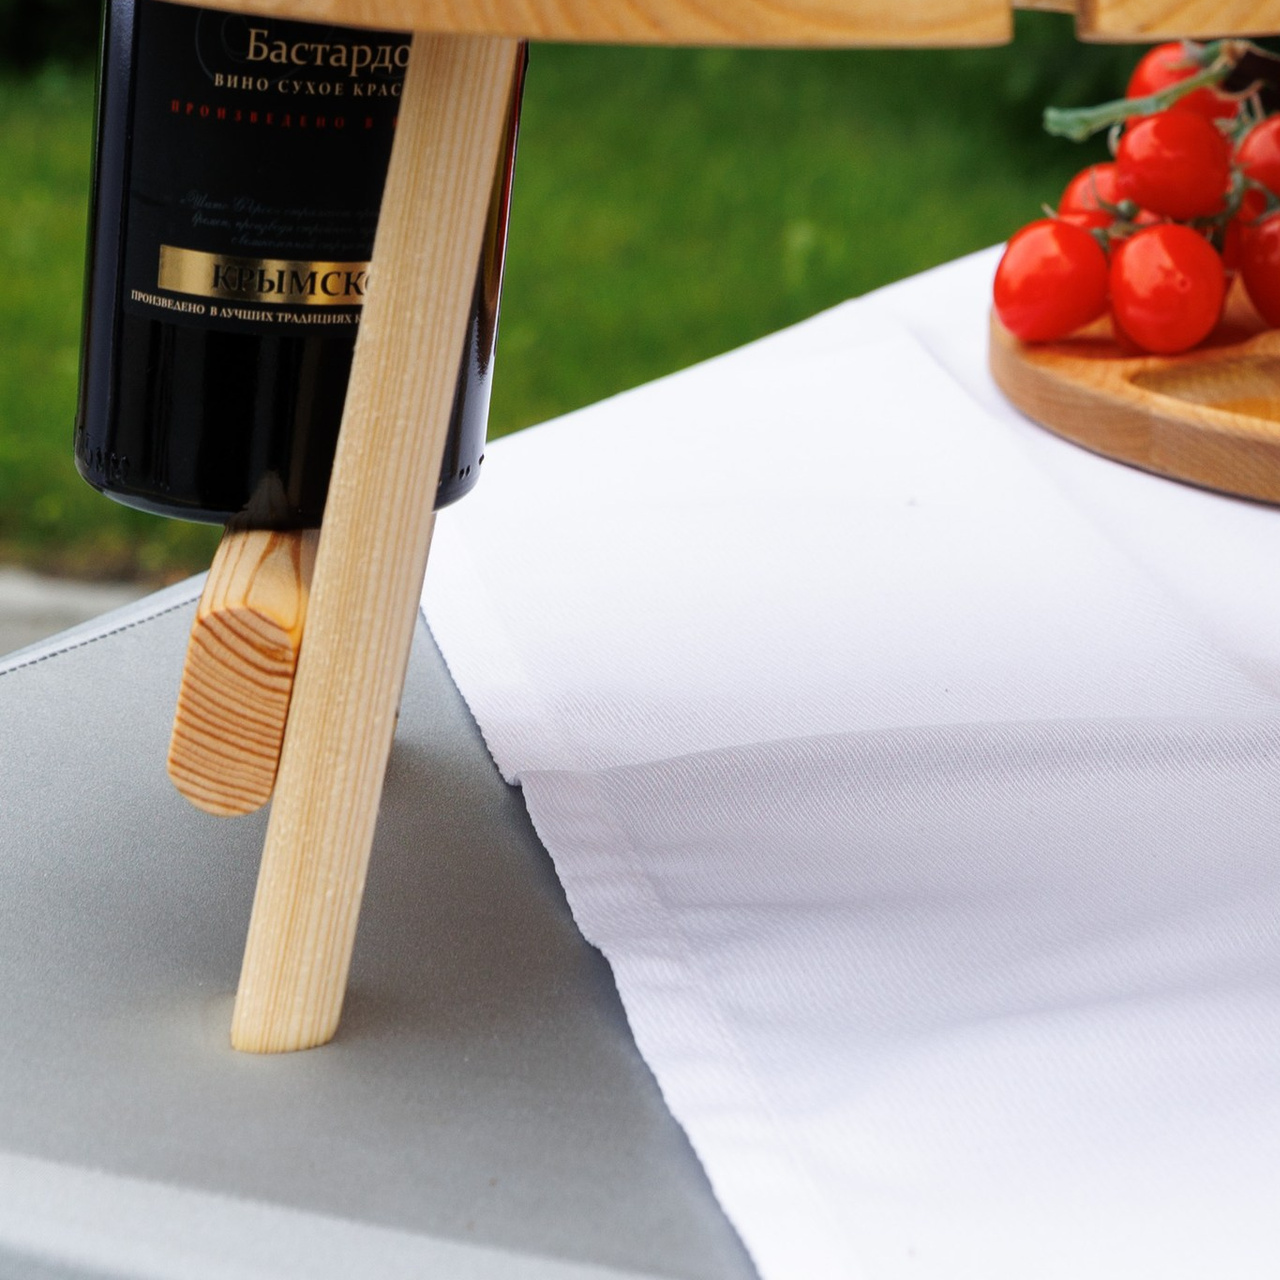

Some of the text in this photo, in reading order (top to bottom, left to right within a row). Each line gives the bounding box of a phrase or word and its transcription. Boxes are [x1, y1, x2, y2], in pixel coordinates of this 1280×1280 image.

[246, 28, 411, 77] Бастардо
[214, 72, 270, 92] ВИНО
[278, 79, 344, 97] СУХОЕ
[171, 98, 344, 130] ПРОИЗВЕДЕНО
[131, 289, 206, 315] ПРОИЗВЕДЕНО
[210, 305, 218, 317] В
[219, 306, 274, 322] ЛУЧШИХ
[276, 311, 352, 326] ТРАДИЦИЯХ
